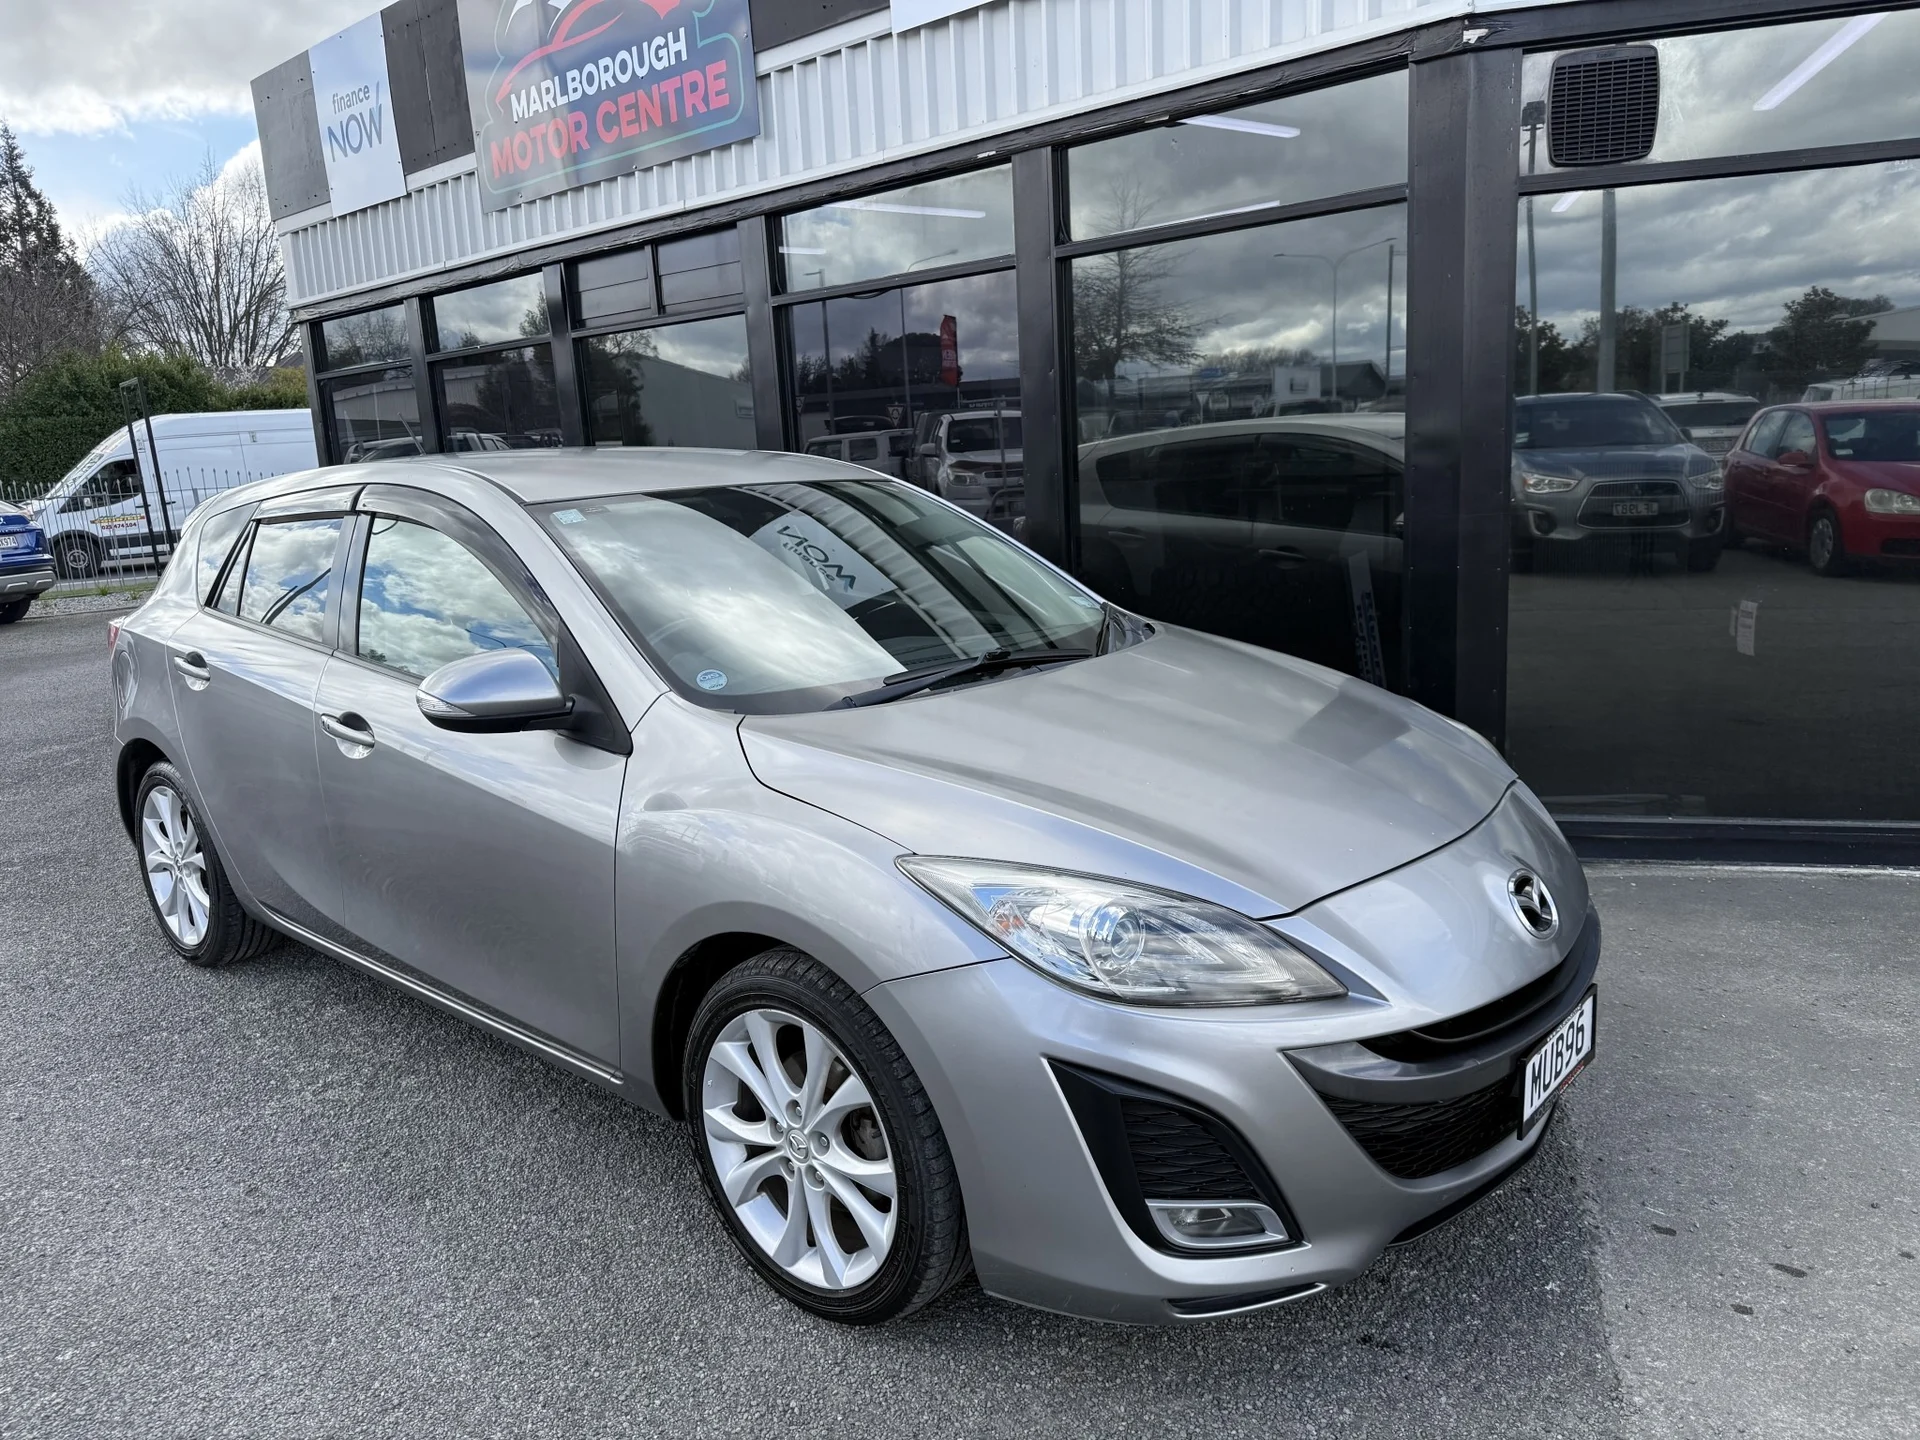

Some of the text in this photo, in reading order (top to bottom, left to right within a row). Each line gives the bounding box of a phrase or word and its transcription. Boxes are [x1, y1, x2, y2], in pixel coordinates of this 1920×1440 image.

[332, 84, 370, 115] finance
[490, 59, 730, 179] MOTOR CENTRE
[510, 27, 688, 122] MARLBOROUGH
[327, 103, 382, 163] NOW
[1530, 1009, 1585, 1109] MUB96
